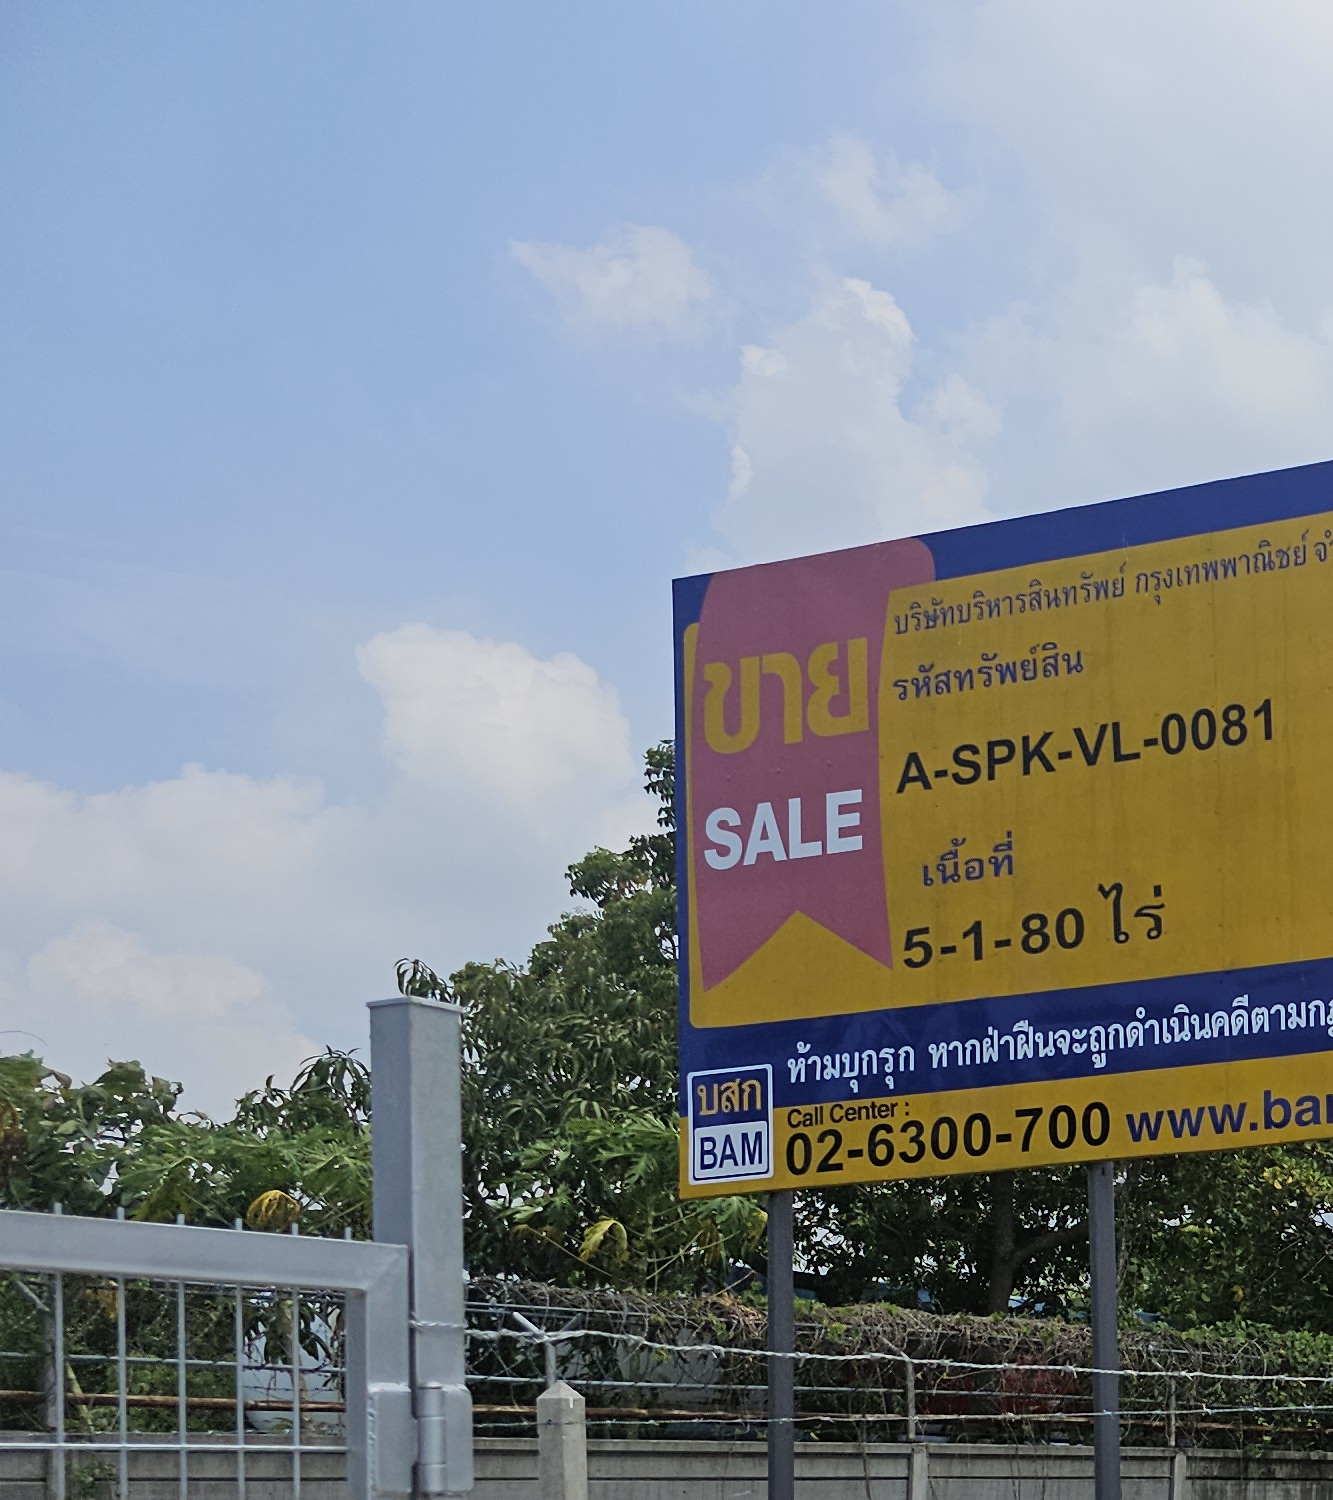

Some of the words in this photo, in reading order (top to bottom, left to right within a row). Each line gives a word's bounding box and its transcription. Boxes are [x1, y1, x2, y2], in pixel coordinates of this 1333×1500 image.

[894, 562, 1127, 635] บริษัทบริหารสินทรัพย์
[1135, 529, 1309, 605] กรุงเทพพาณิชย์
[704, 637, 869, 754] ขาย
[892, 641, 1084, 701] รหัสทรัพย์สิน
[895, 698, 1274, 795] A-SPK-VL-0081
[703, 788, 863, 871] SALE
[923, 830, 1015, 887] เนื้อที่
[902, 907, 1086, 970] 5-1-80
[1098, 882, 1166, 944] ไร่
[697, 1077, 763, 1117] บสก
[787, 1041, 915, 1094] ห้ามบุกรุก
[785, 1101, 1111, 1177] 02-6300-700
[787, 1106, 825, 1130] Call
[829, 1099, 900, 1123] Center
[700, 1131, 764, 1171] BAM
